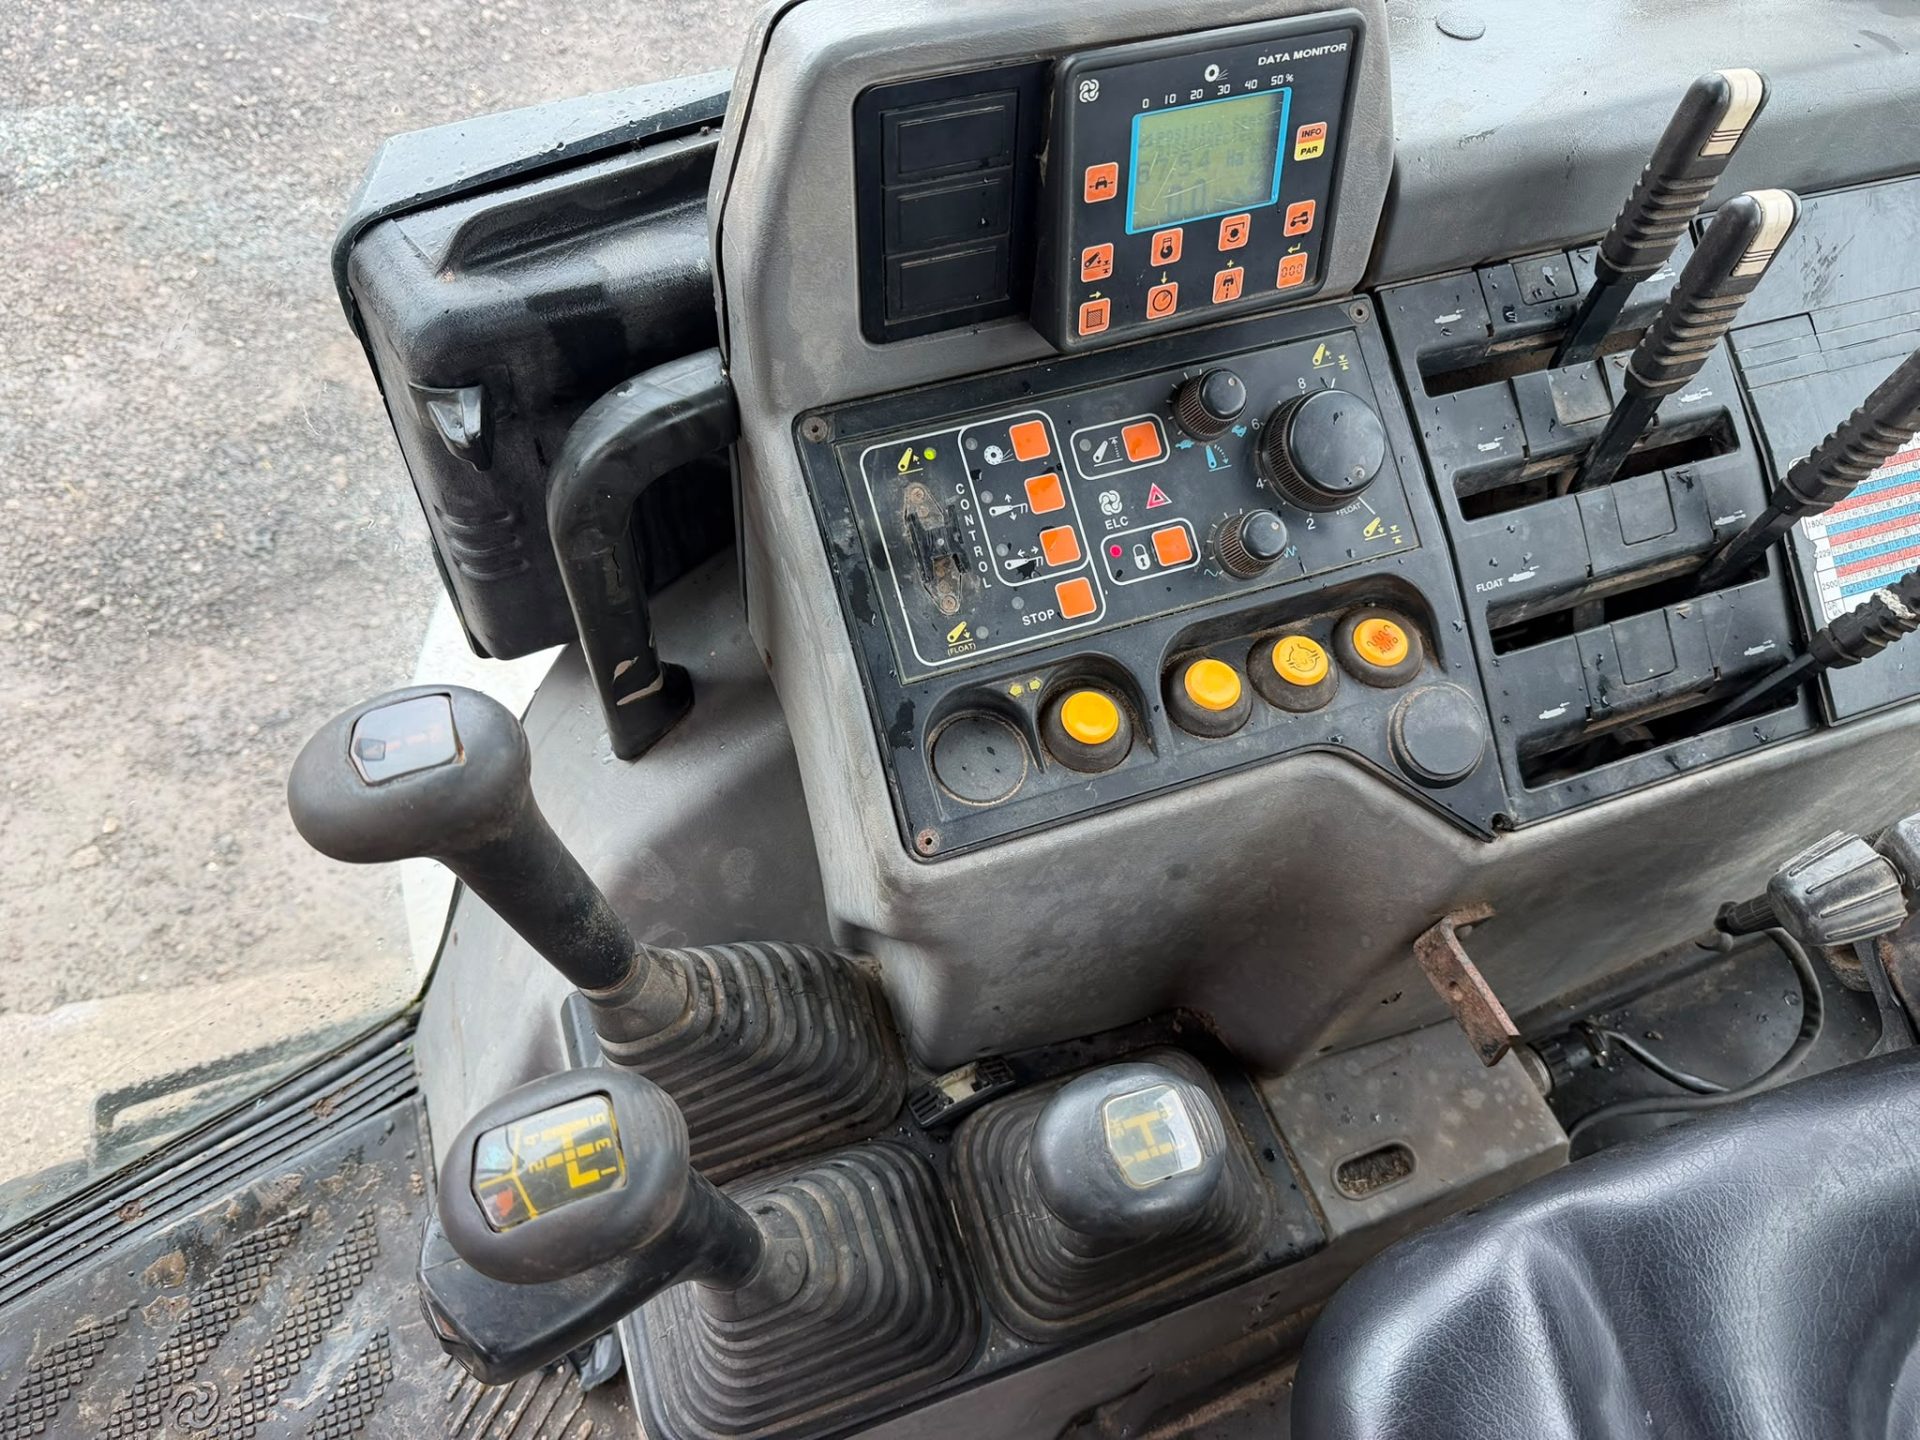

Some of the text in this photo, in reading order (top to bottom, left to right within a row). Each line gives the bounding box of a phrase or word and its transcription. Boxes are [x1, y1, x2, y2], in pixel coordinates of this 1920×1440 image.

[1258, 43, 1347, 66] DATA MONITOR
[1142, 98, 1149, 108] 0
[1164, 93, 1177, 105] 10
[1190, 89, 1203, 100] 20
[1217, 84, 1230, 95] 30
[1245, 80, 1258, 90] 40
[1301, 128, 1321, 138] INFO
[1300, 146, 1318, 155] PAR
[1298, 377, 1306, 389] 8
[1251, 418, 1260, 430] 6
[1256, 478, 1264, 489] 4
[1105, 516, 1129, 530] ELC
[1306, 518, 1316, 530] 2
[955, 483, 991, 589] CONTROL
[1476, 578, 1504, 592] FLOAT
[1022, 609, 1055, 626] STOP
[947, 643, 977, 656] (FLOAT)
